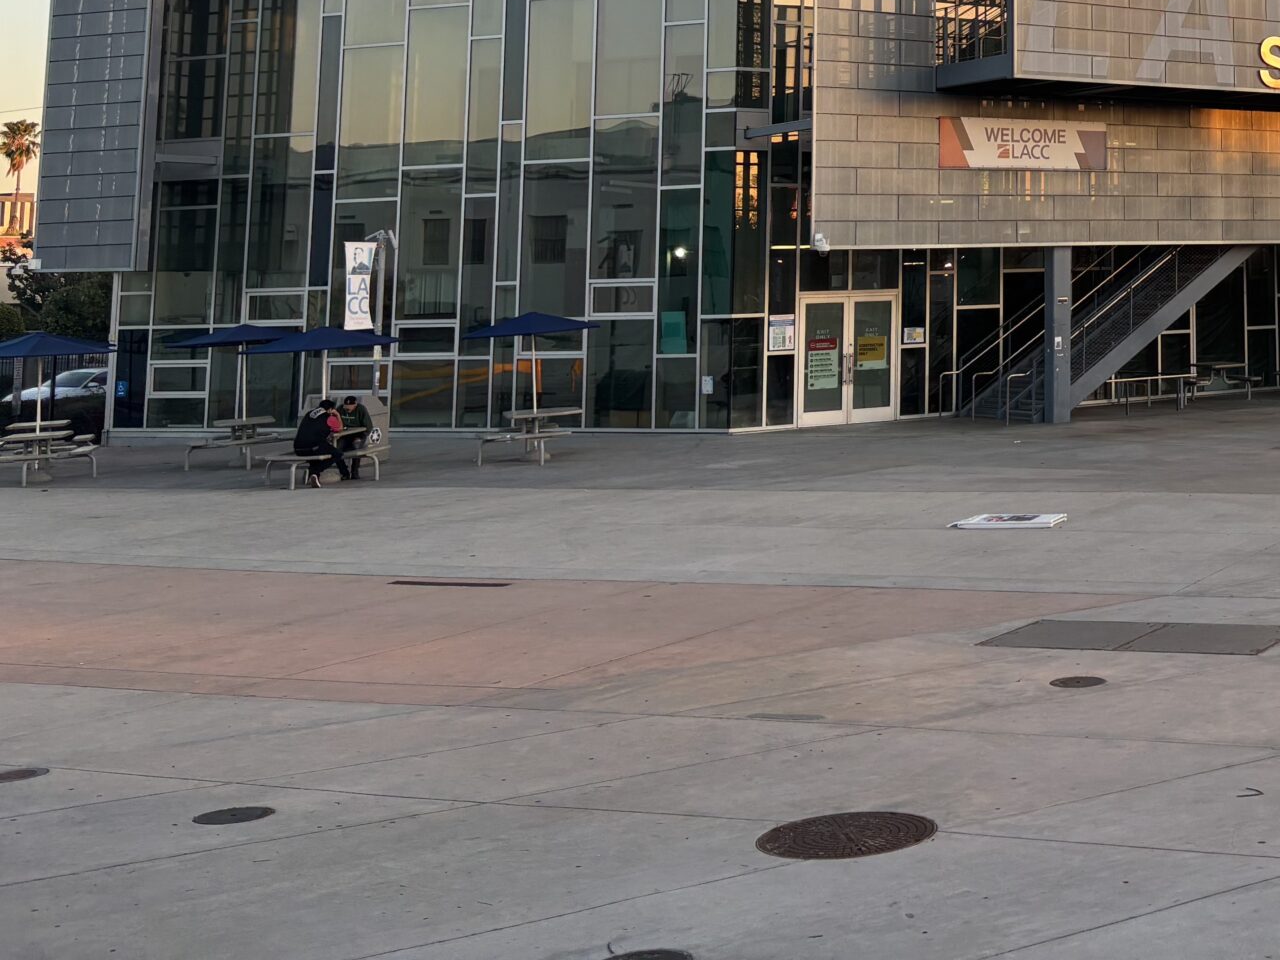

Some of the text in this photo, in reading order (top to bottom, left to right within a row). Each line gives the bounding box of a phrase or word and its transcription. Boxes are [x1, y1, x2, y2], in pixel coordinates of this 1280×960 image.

[984, 127, 1066, 144] WELCOME
[1011, 144, 1050, 159] LACC
[347, 277, 369, 296] LA
[347, 296, 369, 315] CC
